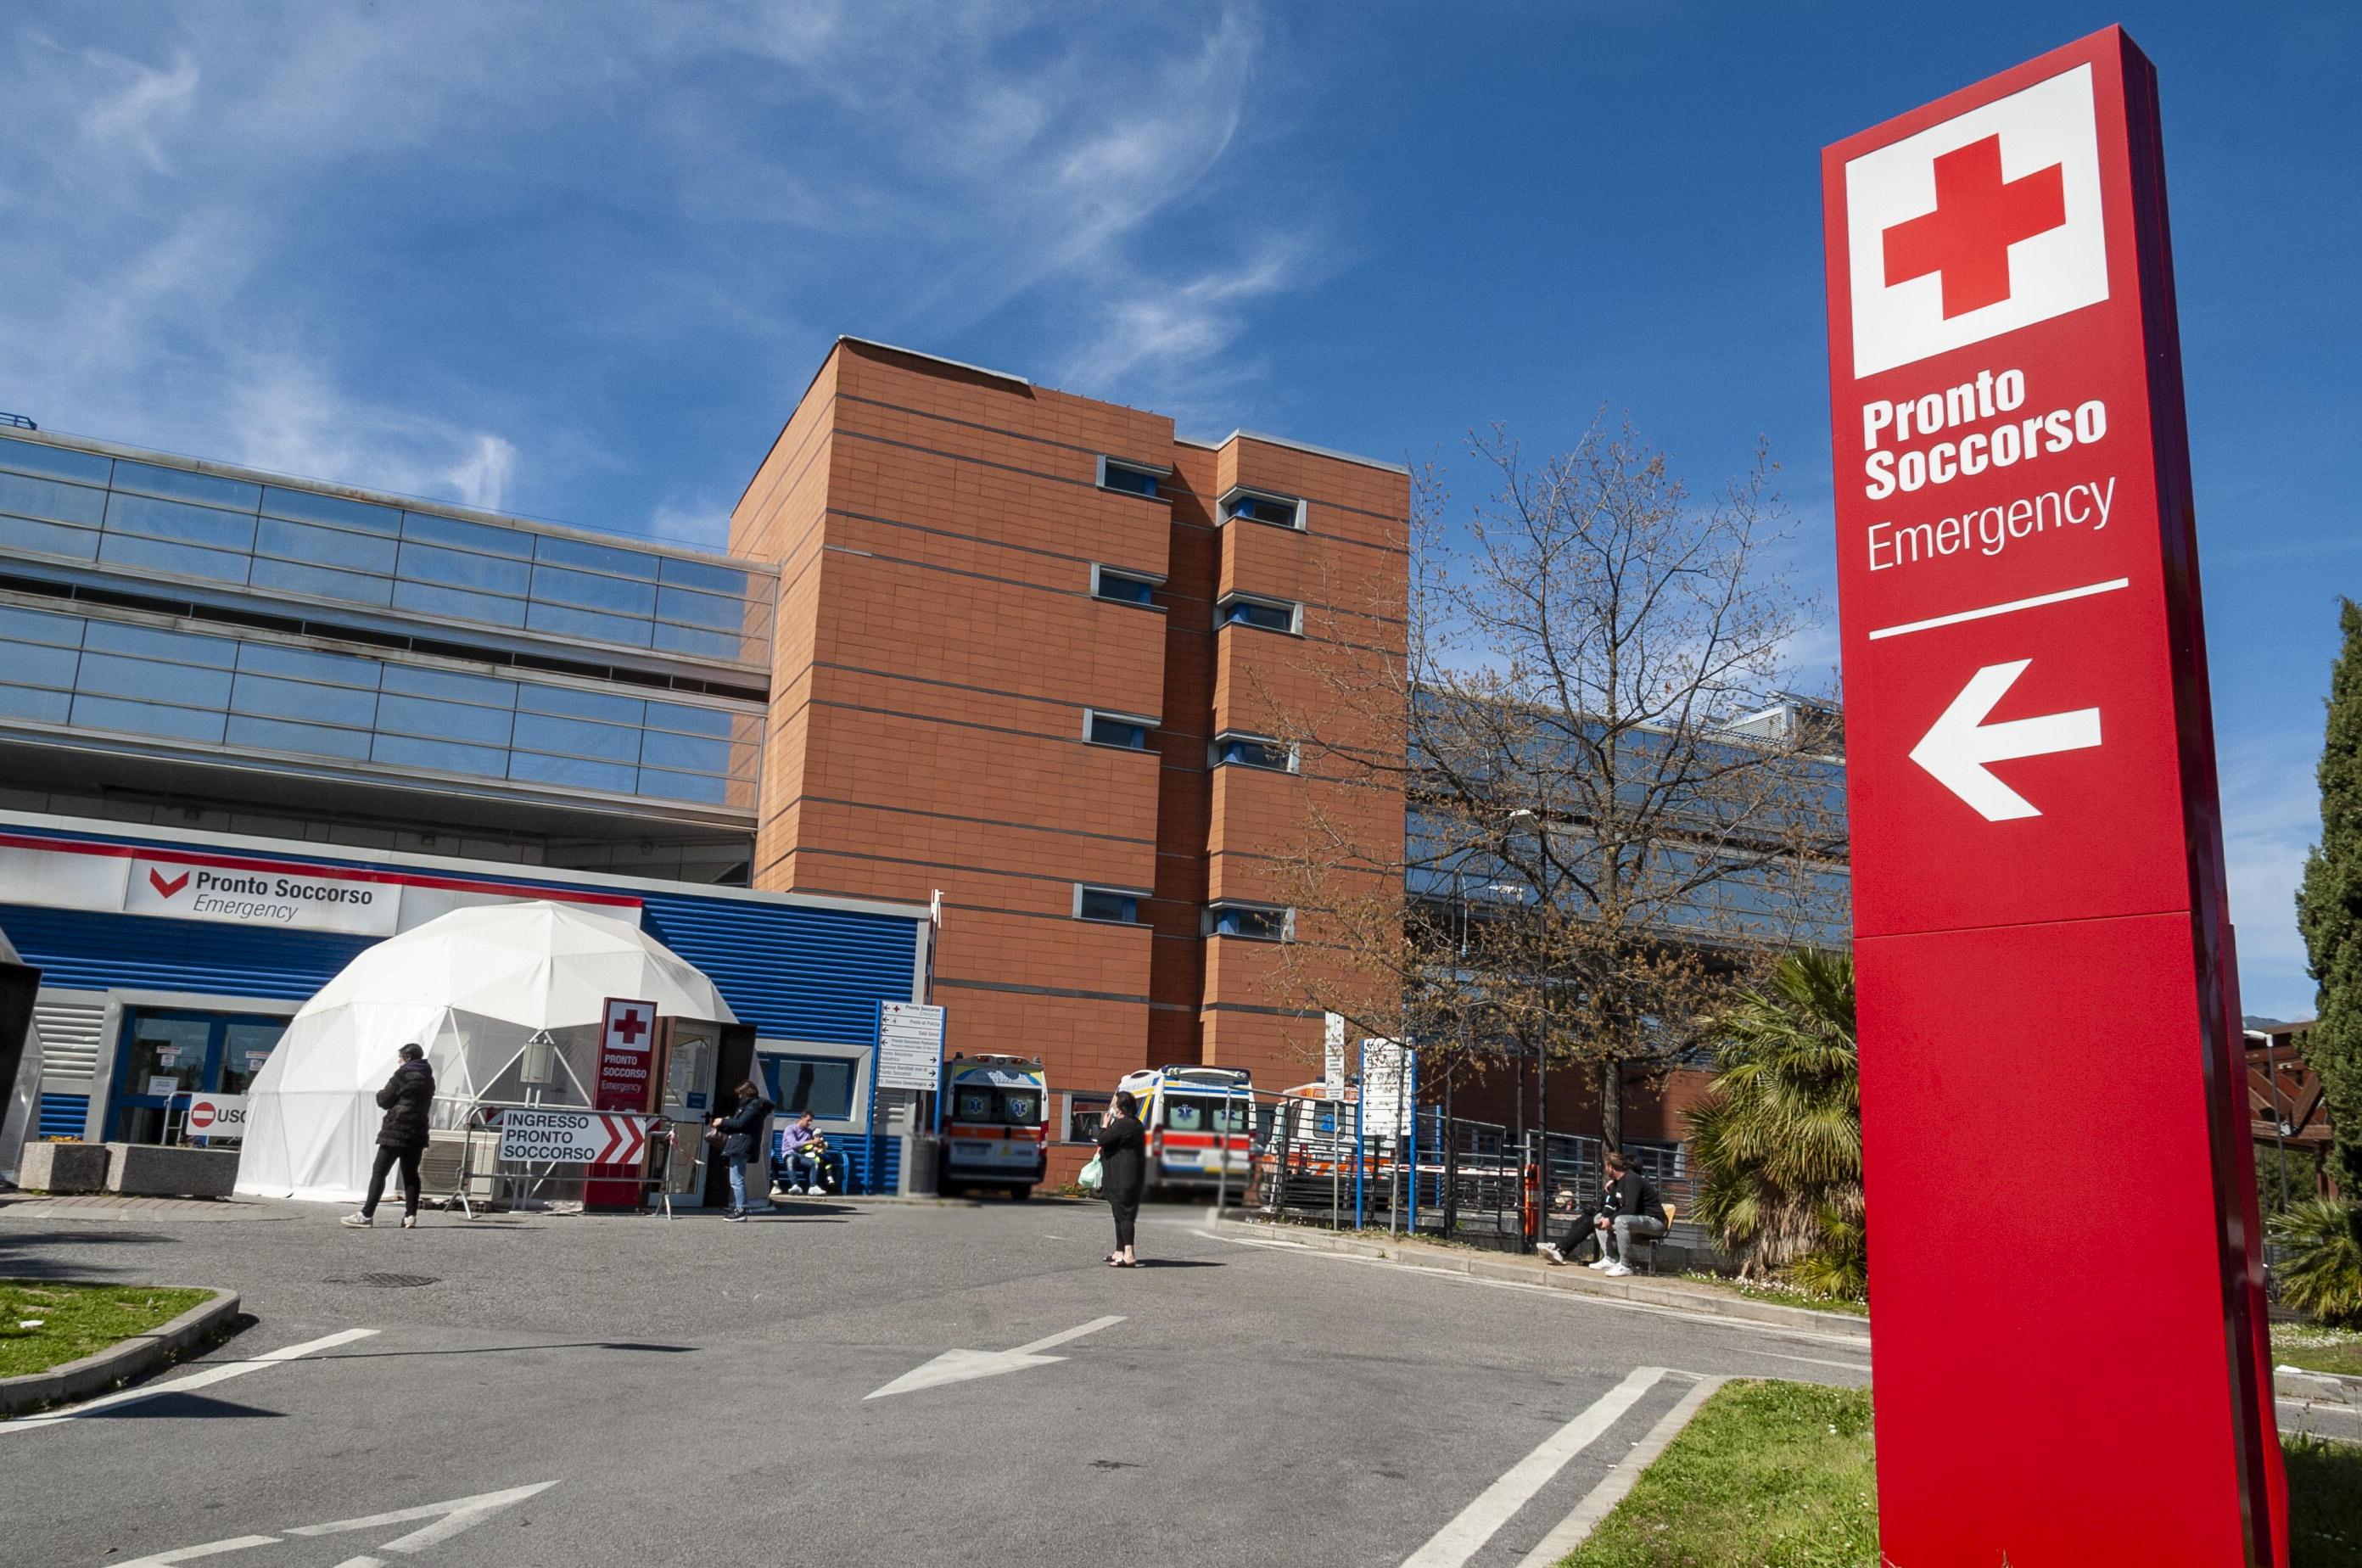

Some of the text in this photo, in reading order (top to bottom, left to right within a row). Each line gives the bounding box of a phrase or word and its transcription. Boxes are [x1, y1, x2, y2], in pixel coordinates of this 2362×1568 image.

[1862, 368, 2025, 451] Pronto
[1865, 400, 2107, 501] Soccorso
[1867, 476, 2116, 571] Emergency
[196, 871, 372, 904] Pronto Soccorso
[193, 893, 299, 922] Emergency
[604, 1054, 638, 1066] PRONTO
[603, 1067, 647, 1079] SOCCORSO
[602, 1080, 642, 1094] Emergency
[507, 1113, 589, 1129] INGRESSO
[506, 1129, 574, 1144] PRONTO
[504, 1145, 596, 1160] SOCCORSO
